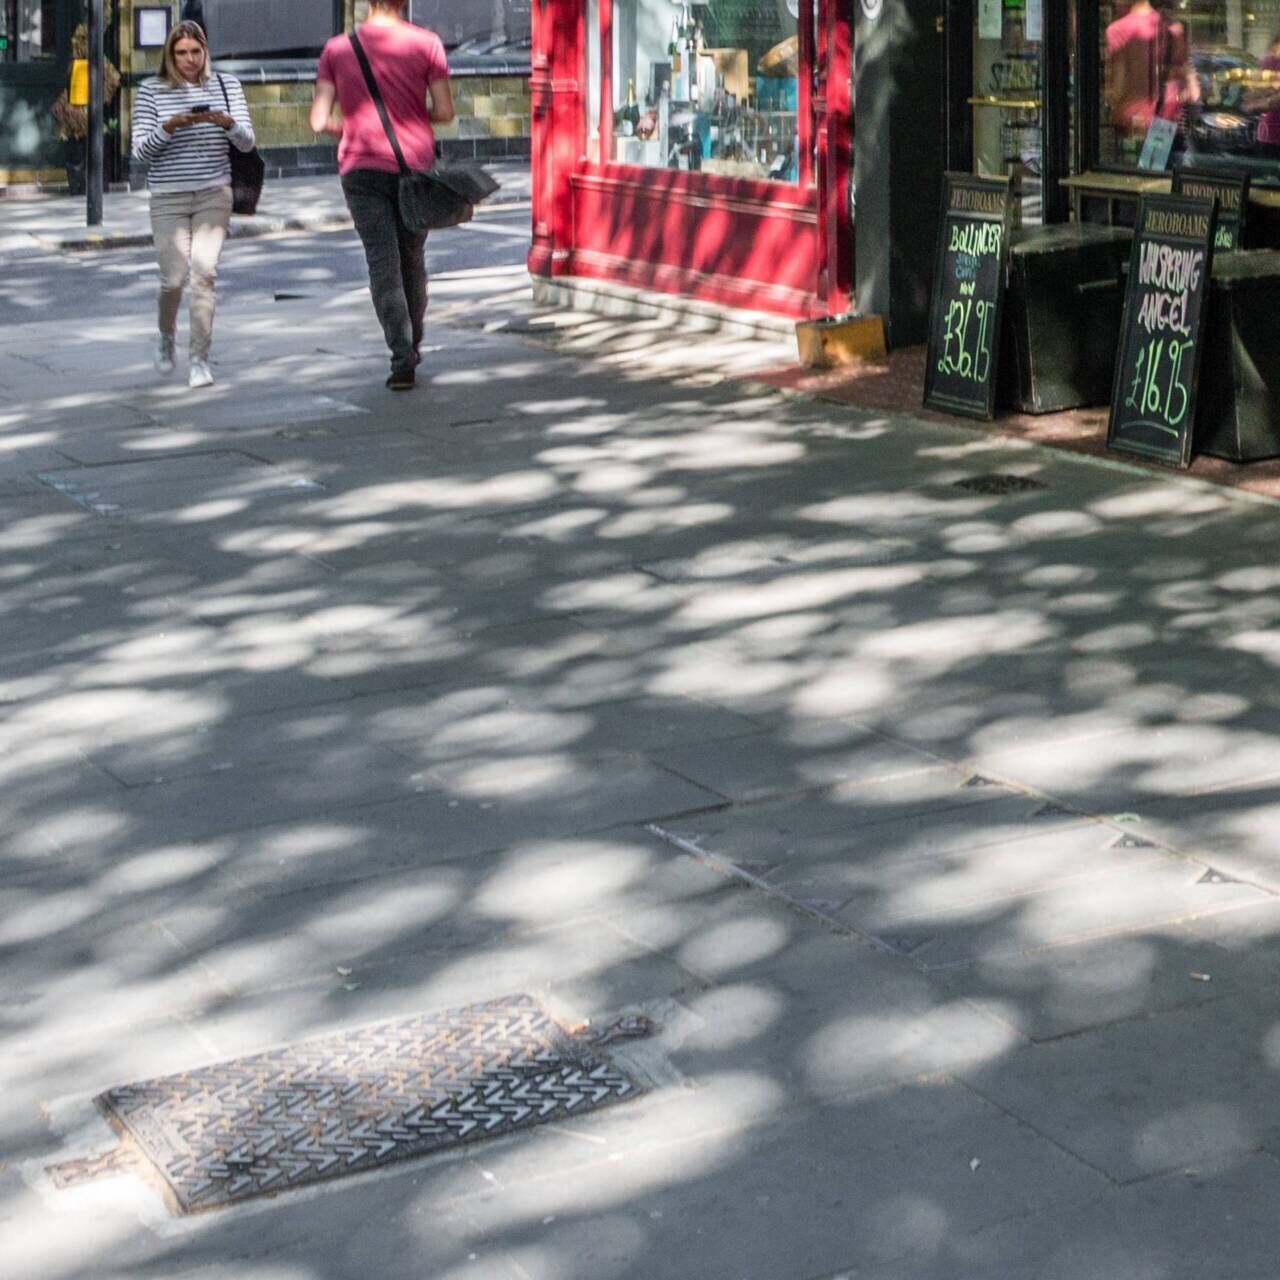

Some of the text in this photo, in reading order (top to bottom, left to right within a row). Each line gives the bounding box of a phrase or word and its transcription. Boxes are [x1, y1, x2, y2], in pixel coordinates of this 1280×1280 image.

[1145, 211, 1208, 235] JEROBOAMS
[1138, 288, 1190, 337] ANGEL
[1125, 337, 1194, 425] £16.95
